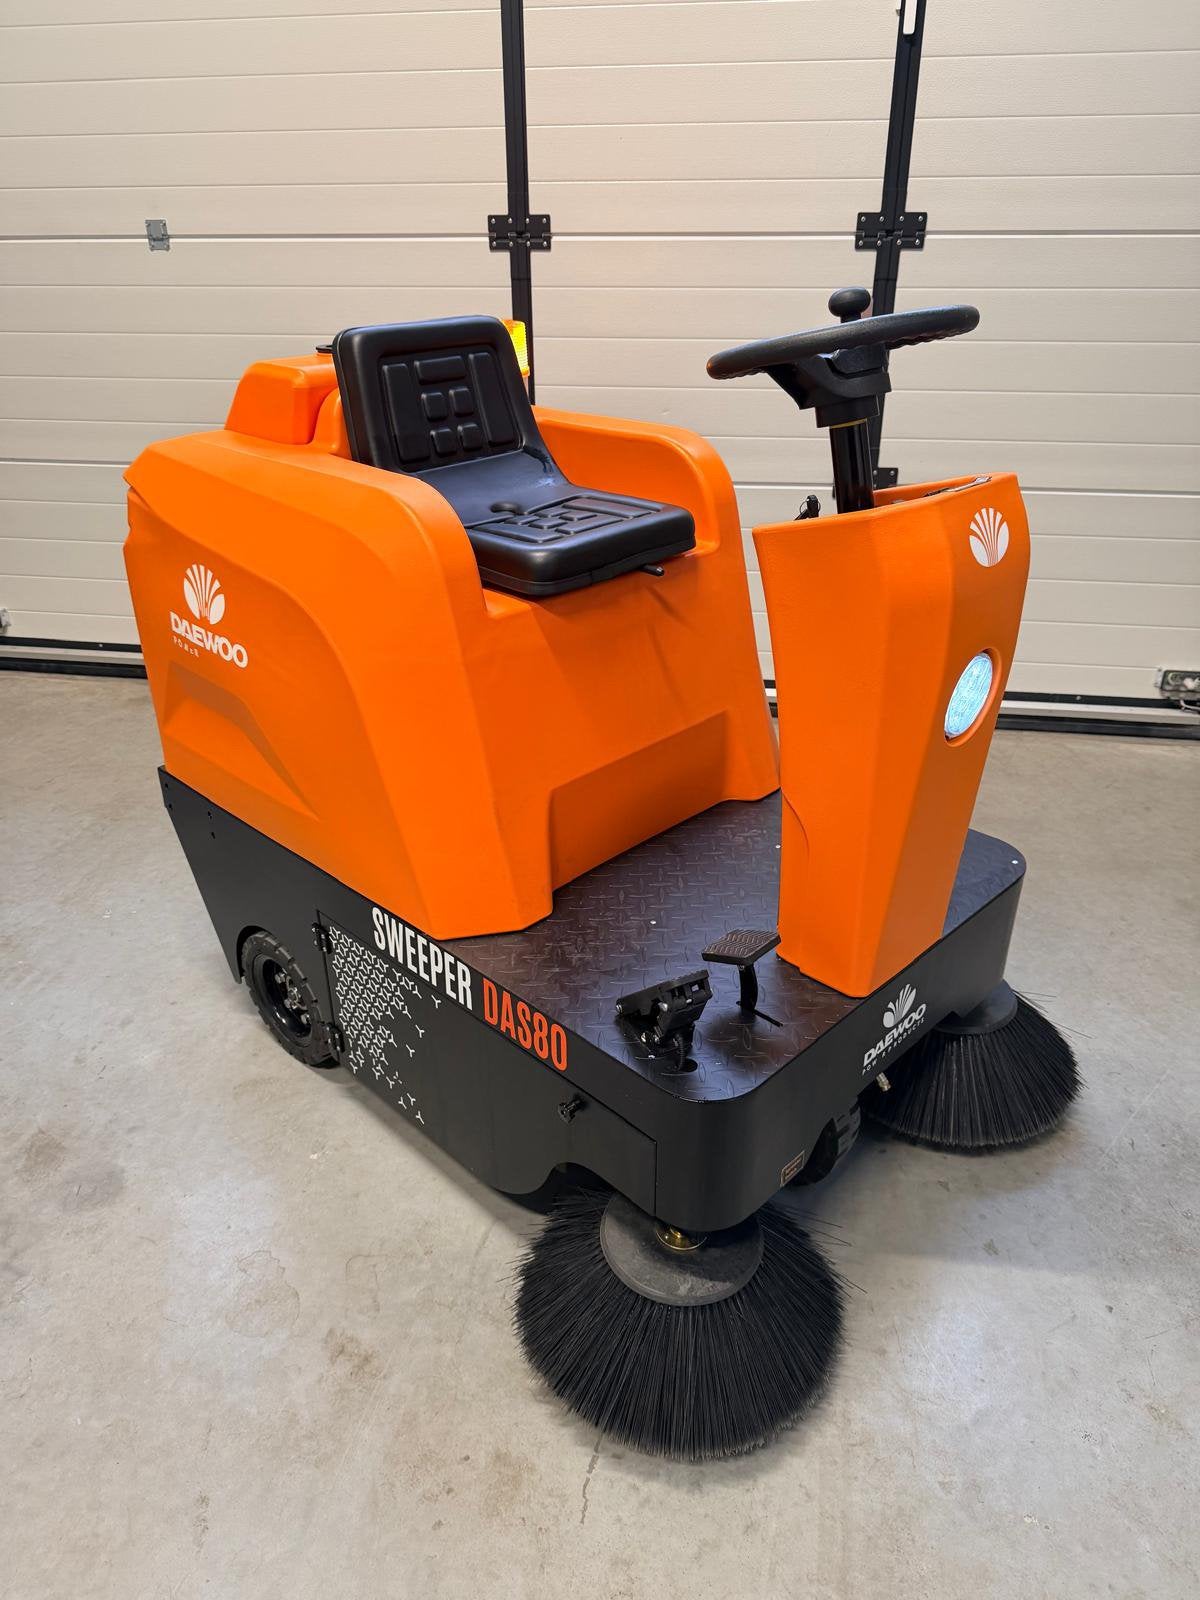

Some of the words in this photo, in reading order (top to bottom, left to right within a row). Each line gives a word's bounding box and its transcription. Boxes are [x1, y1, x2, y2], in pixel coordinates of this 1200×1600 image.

[169, 610, 248, 668] DAEWOO
[372, 907, 473, 1010] SWEEPER
[483, 977, 568, 1072] DAS80
[863, 1003, 927, 1067] DAEWOO
